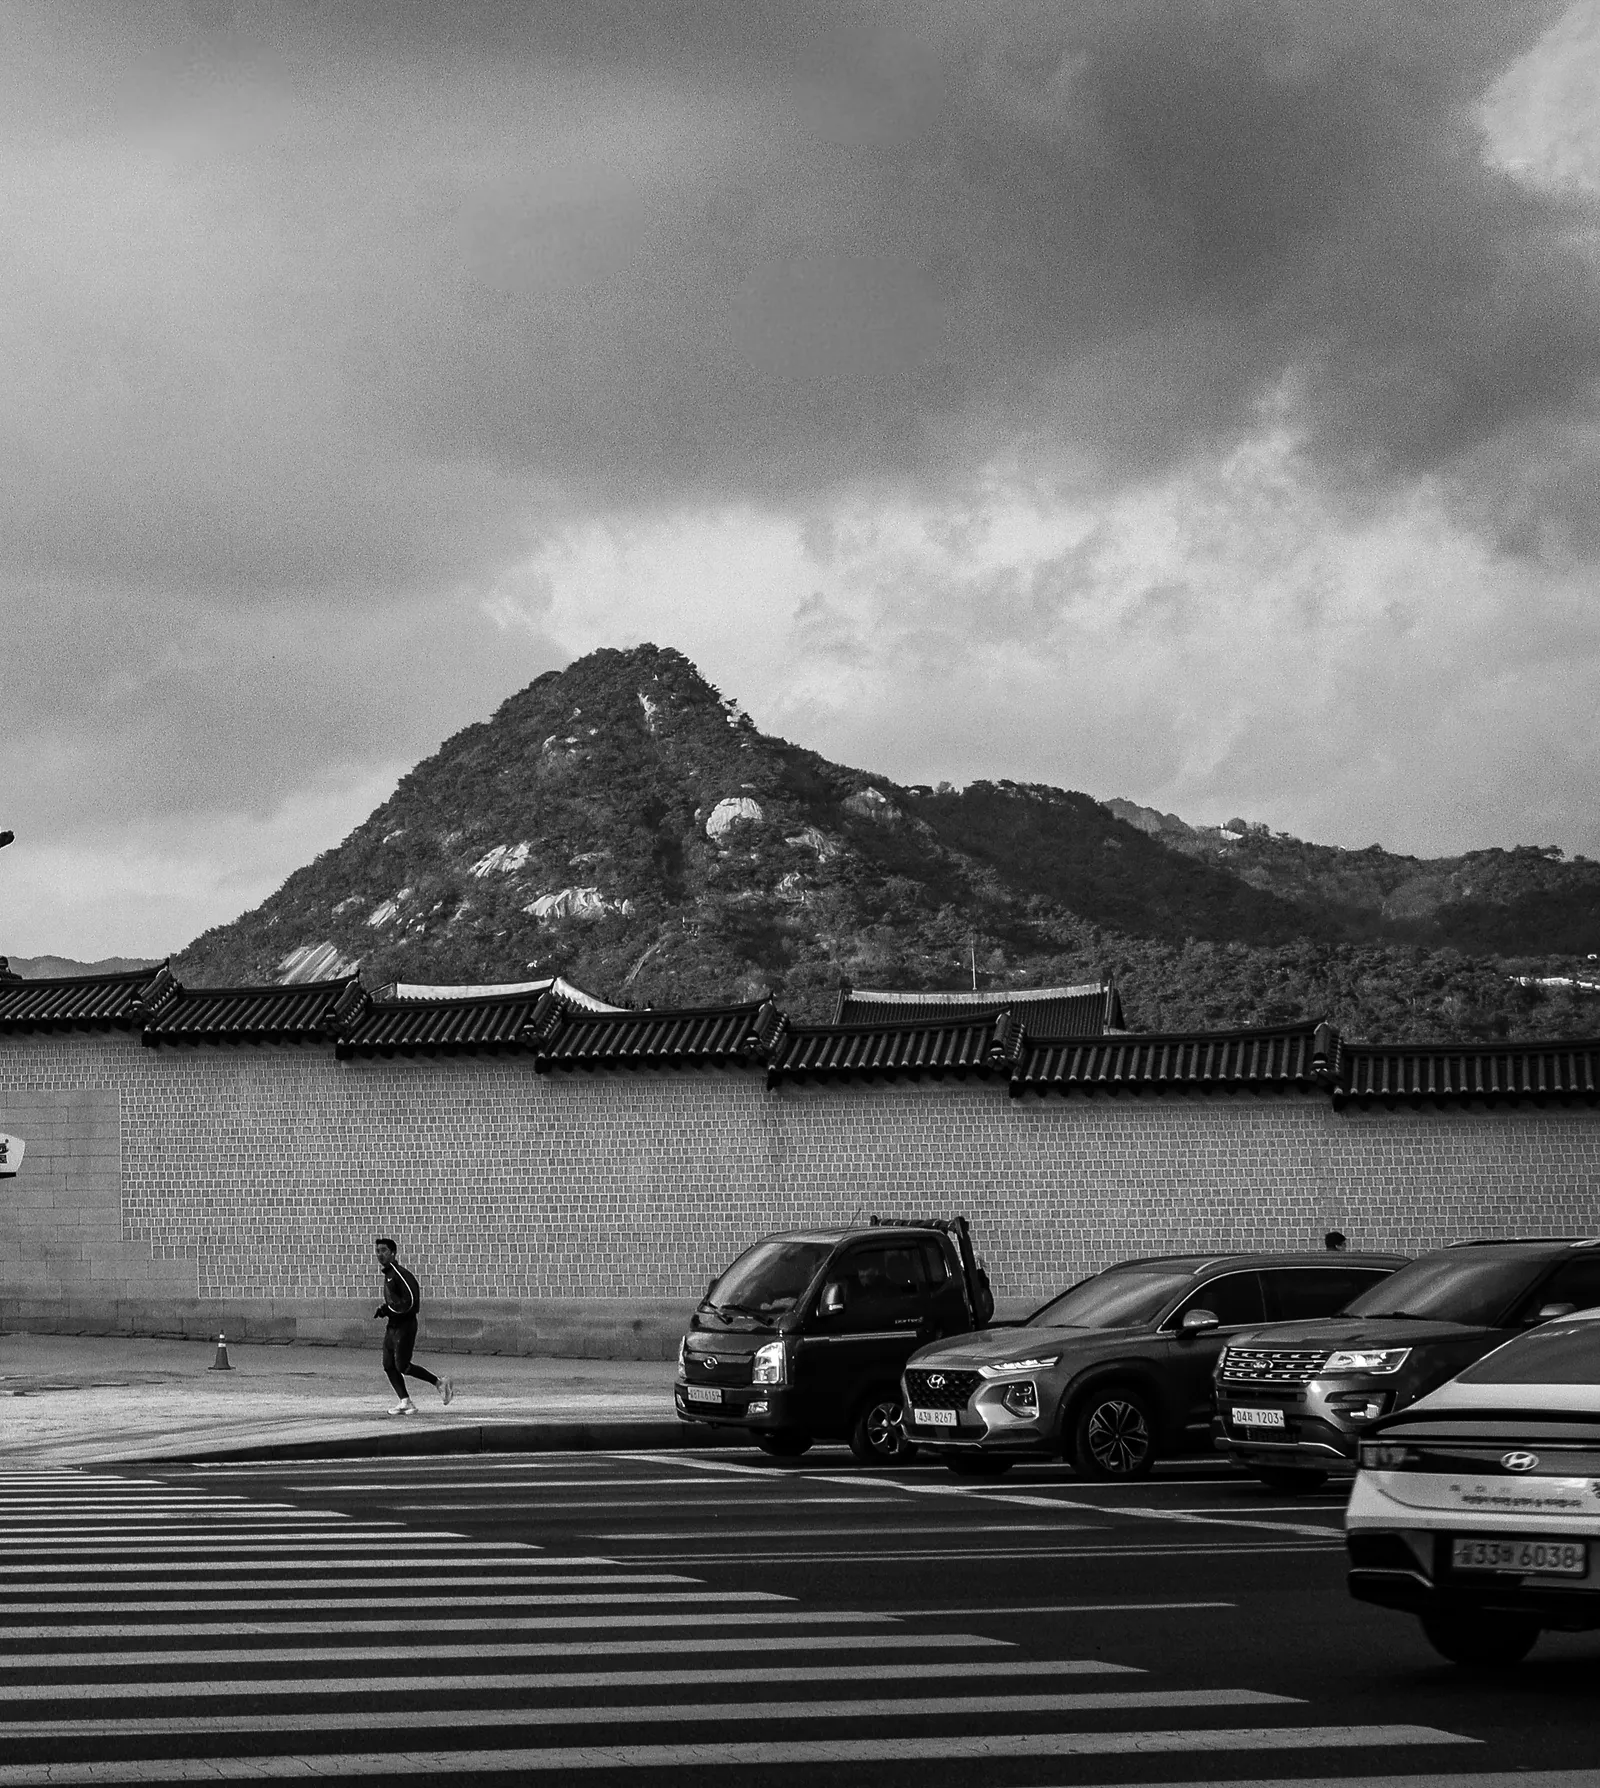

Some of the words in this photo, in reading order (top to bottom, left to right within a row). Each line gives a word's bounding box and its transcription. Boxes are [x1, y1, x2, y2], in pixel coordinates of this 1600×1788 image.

[934, 1411, 952, 1423] 8267
[1257, 1411, 1279, 1424] 1203
[1519, 1544, 1575, 1568] 6038
